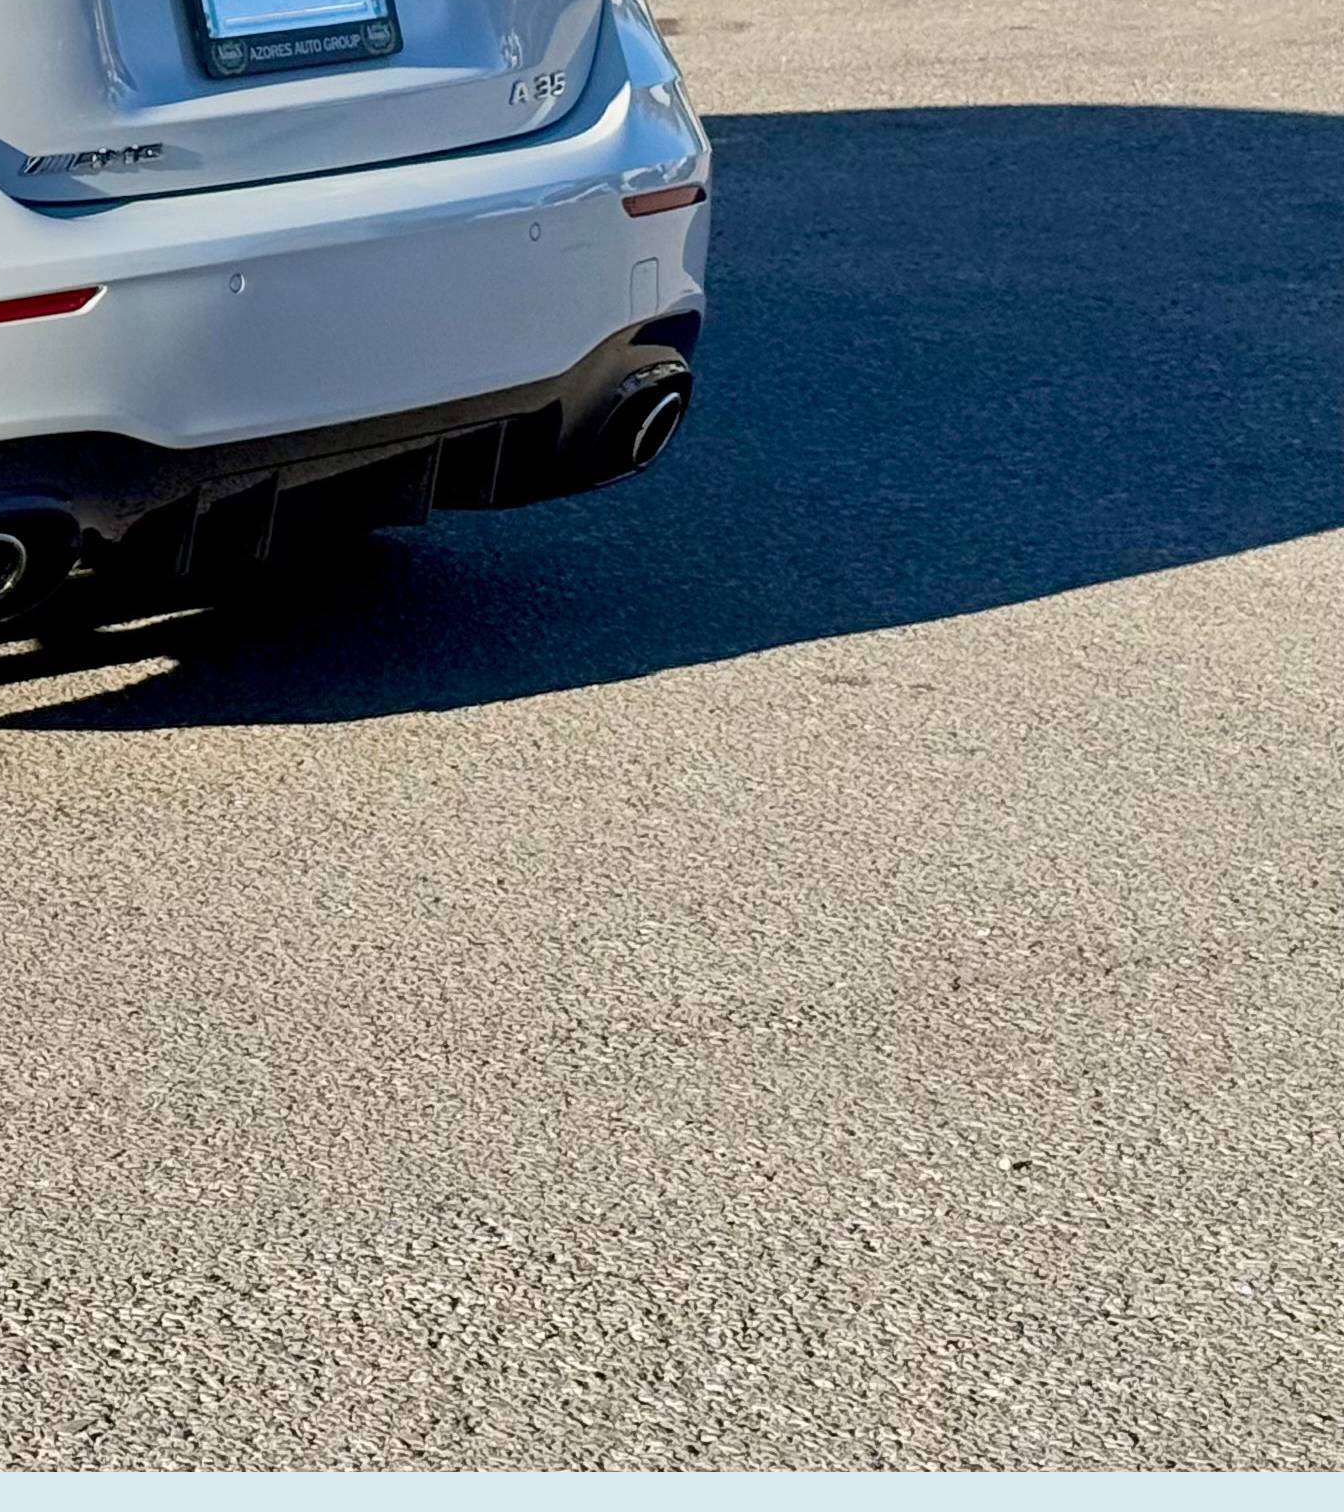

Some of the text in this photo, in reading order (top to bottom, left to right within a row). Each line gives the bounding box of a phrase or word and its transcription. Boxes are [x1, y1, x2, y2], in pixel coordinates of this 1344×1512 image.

[250, 42, 293, 60] AZORES
[294, 39, 322, 56] AUTO
[323, 33, 361, 51] GROUP
